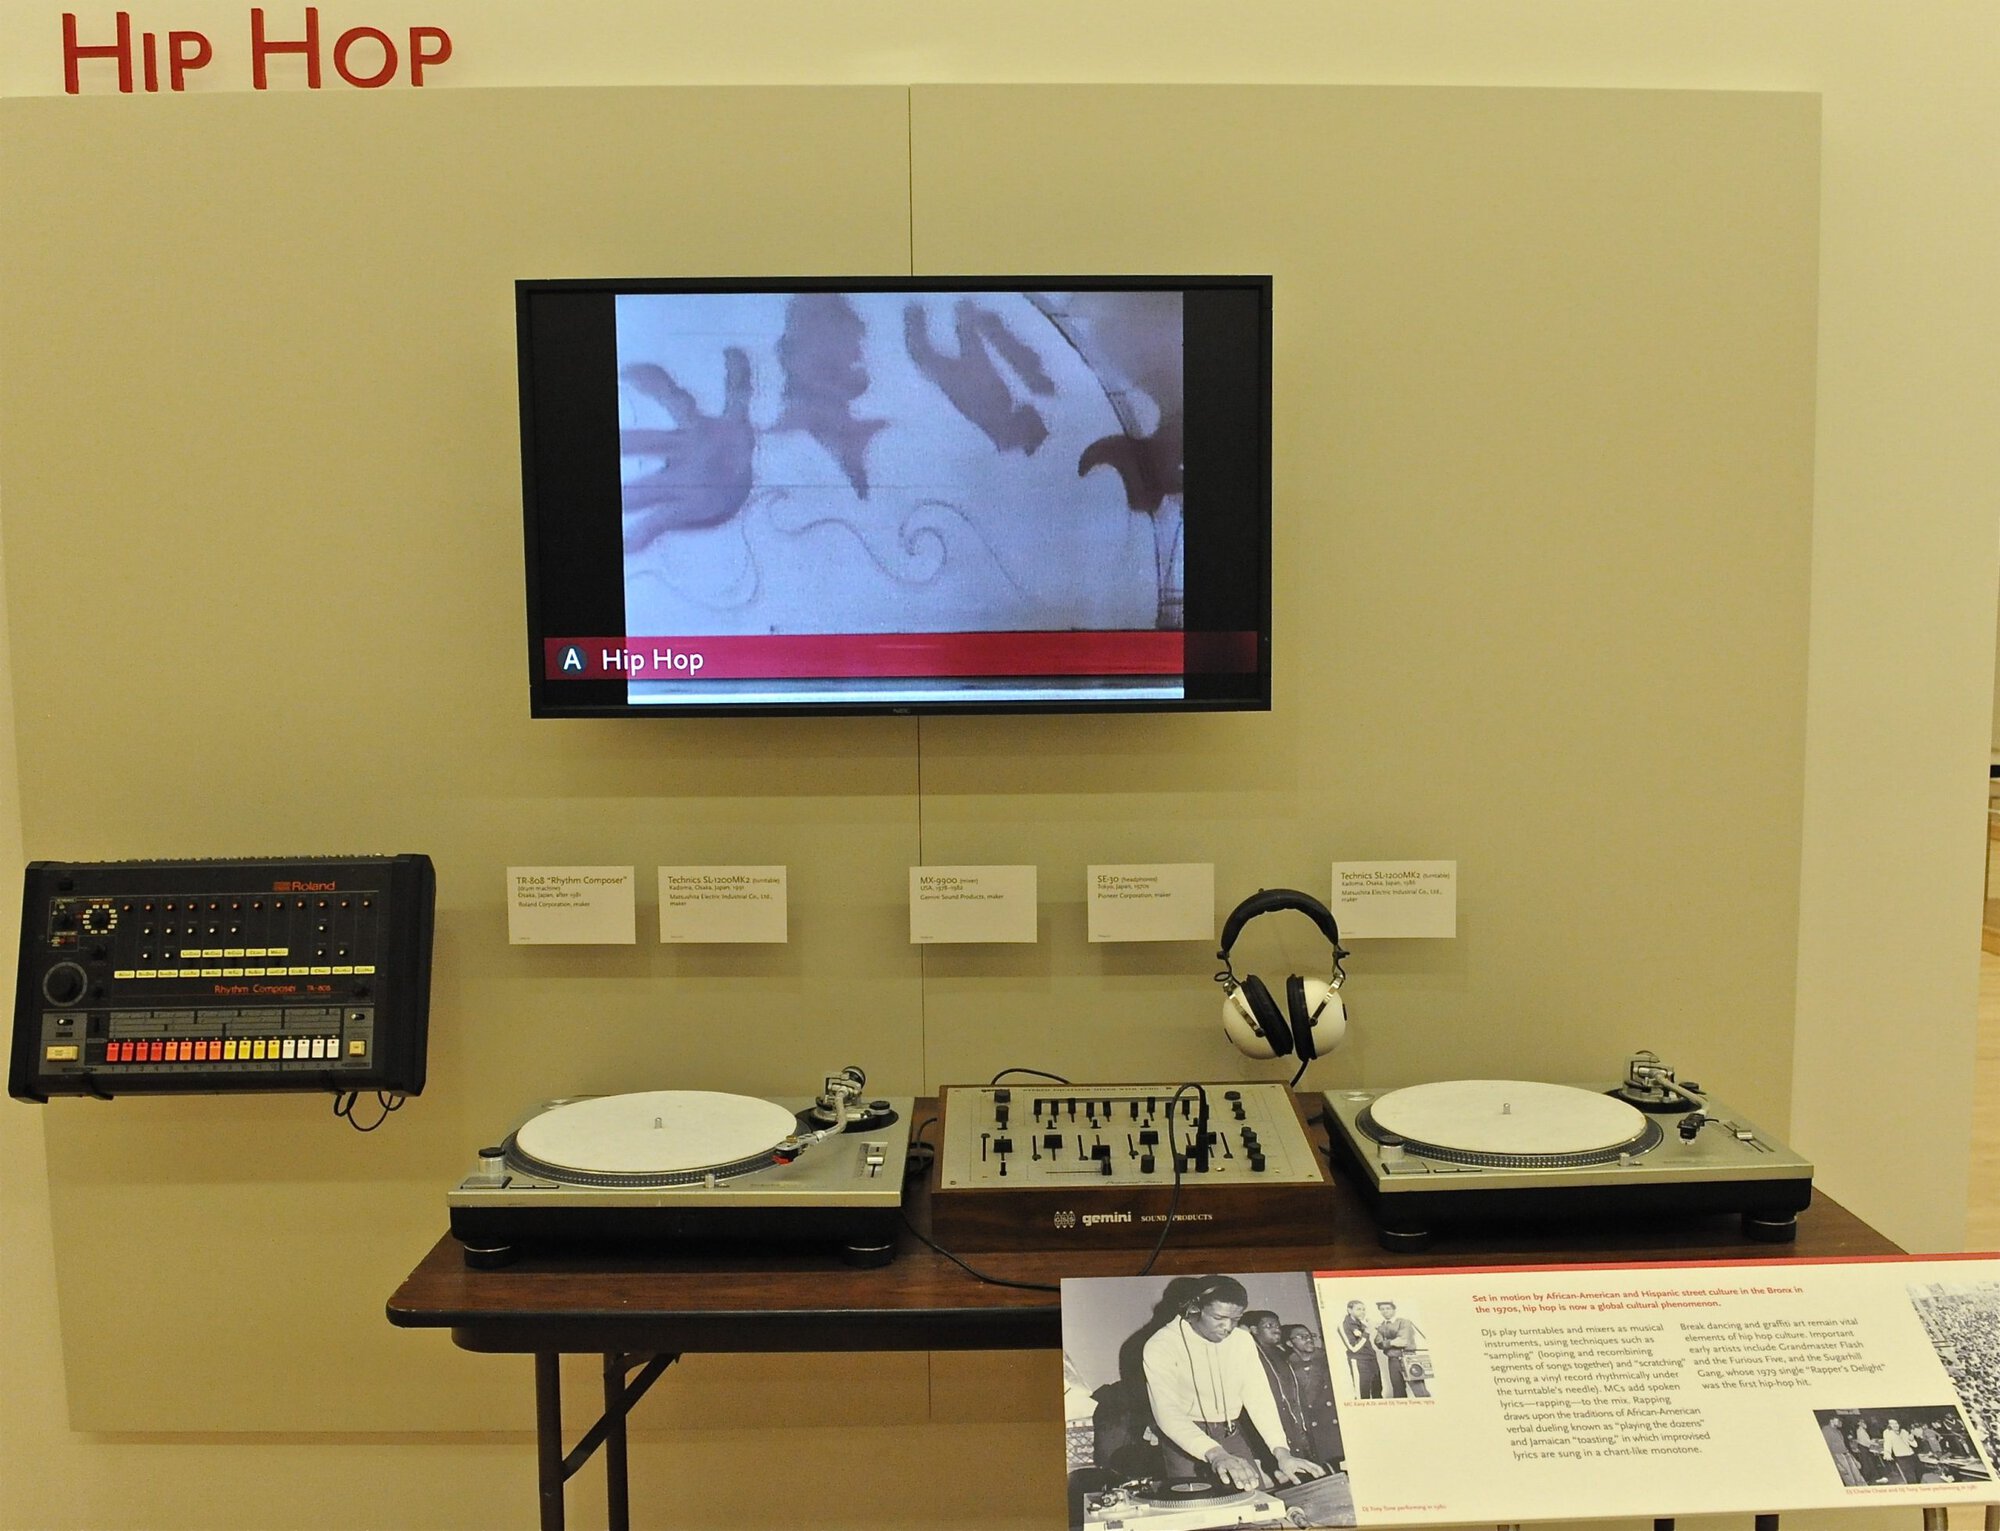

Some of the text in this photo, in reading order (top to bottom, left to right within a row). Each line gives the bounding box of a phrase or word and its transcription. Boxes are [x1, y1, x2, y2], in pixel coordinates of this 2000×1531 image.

[62, 7, 452, 94] HIP HOP
[562, 648, 582, 670] A
[602, 649, 704, 676] Hip Hop
[548, 876, 581, 886] "Rhythm
[583, 876, 627, 885] Composer"
[920, 877, 957, 885] MX-9900
[1098, 875, 1119, 884] SE-30
[292, 881, 335, 892] Roland
[215, 985, 249, 994] Rhythm
[253, 984, 296, 993] Composer
[1082, 1211, 1132, 1226] gemini
[1533, 1293, 1544, 1302] by
[1546, 1291, 1621, 1300] African-American
[1641, 1289, 1680, 1299] Hispanic
[1522, 1304, 1537, 1313] hip
[1539, 1304, 1557, 1312] hop
[1597, 1302, 1624, 1312] global
[1626, 1301, 1659, 1309] cultural
[1661, 1300, 1721, 1310] phenomenon.
[1481, 1329, 1497, 1338] DJs
[1500, 1328, 1517, 1338] play
[1519, 1327, 1564, 1335] turntables
[1567, 1326, 1583, 1334] and
[1630, 1323, 1664, 1331] musical
[1680, 1322, 1706, 1330] Break
[1707, 1322, 1743, 1330] dancing
[1763, 1320, 1791, 1330] graffiti
[1570, 1337, 1619, 1346] techniques
[1728, 1332, 1737, 1340] of
[1738, 1333, 1754, 1342] hip
[1754, 1332, 1773, 1341] hop
[1809, 1330, 1854, 1339] Important
[1484, 1351, 1534, 1361] "sampling"
[1538, 1350, 1576, 1360] (looping
[1597, 1348, 1654, 1357] recombining
[1689, 1345, 1710, 1355] early
[1778, 1342, 1837, 1350] Grandmaster
[1788, 1354, 1805, 1362] and
[1823, 1352, 1862, 1362] Sugarhill
[1491, 1364, 1534, 1373] segments
[1535, 1362, 1544, 1370] of
[1574, 1360, 1614, 1371] together)
[1634, 1358, 1686, 1368] "scratching"
[1697, 1370, 1724, 1379] Gang,
[1756, 1369, 1777, 1377] 1979
[1779, 1366, 1804, 1376] single
[1806, 1365, 1849, 1375] "Rapper's
[1850, 1364, 1886, 1374] Delight"
[1494, 1376, 1532, 1385] (moving
[1541, 1374, 1562, 1383] vinyl
[1564, 1372, 1593, 1381] record
[1596, 1371, 1650, 1382] rhythmically
[1758, 1379, 1794, 1389] hip-hop
[1514, 1386, 1563, 1395] turntable's
[1566, 1385, 1602, 1394] needle).
[1628, 1383, 1645, 1391] add
[1648, 1383, 1680, 1392] spoken
[1593, 1397, 1608, 1405] the
[1633, 1396, 1672, 1405] Rapping
[1504, 1408, 1701, 1421] draws upon the traditions of African-American
[1506, 1424, 1534, 1433] verbal
[1536, 1424, 1570, 1433] dueling
[1615, 1421, 1652, 1431] "playing
[1652, 1420, 1668, 1428] the
[1670, 1419, 1704, 1428] dozens"
[1511, 1437, 1528, 1446] and
[1530, 1437, 1571, 1447] Jamaican
[1572, 1435, 1619, 1445] "toasting,"
[1632, 1433, 1659, 1442] which
[1660, 1431, 1711, 1443] improvised
[1513, 1450, 1538, 1461] lyrics
[1558, 1451, 1582, 1459] sung
[1604, 1447, 1648, 1456] chant-like
